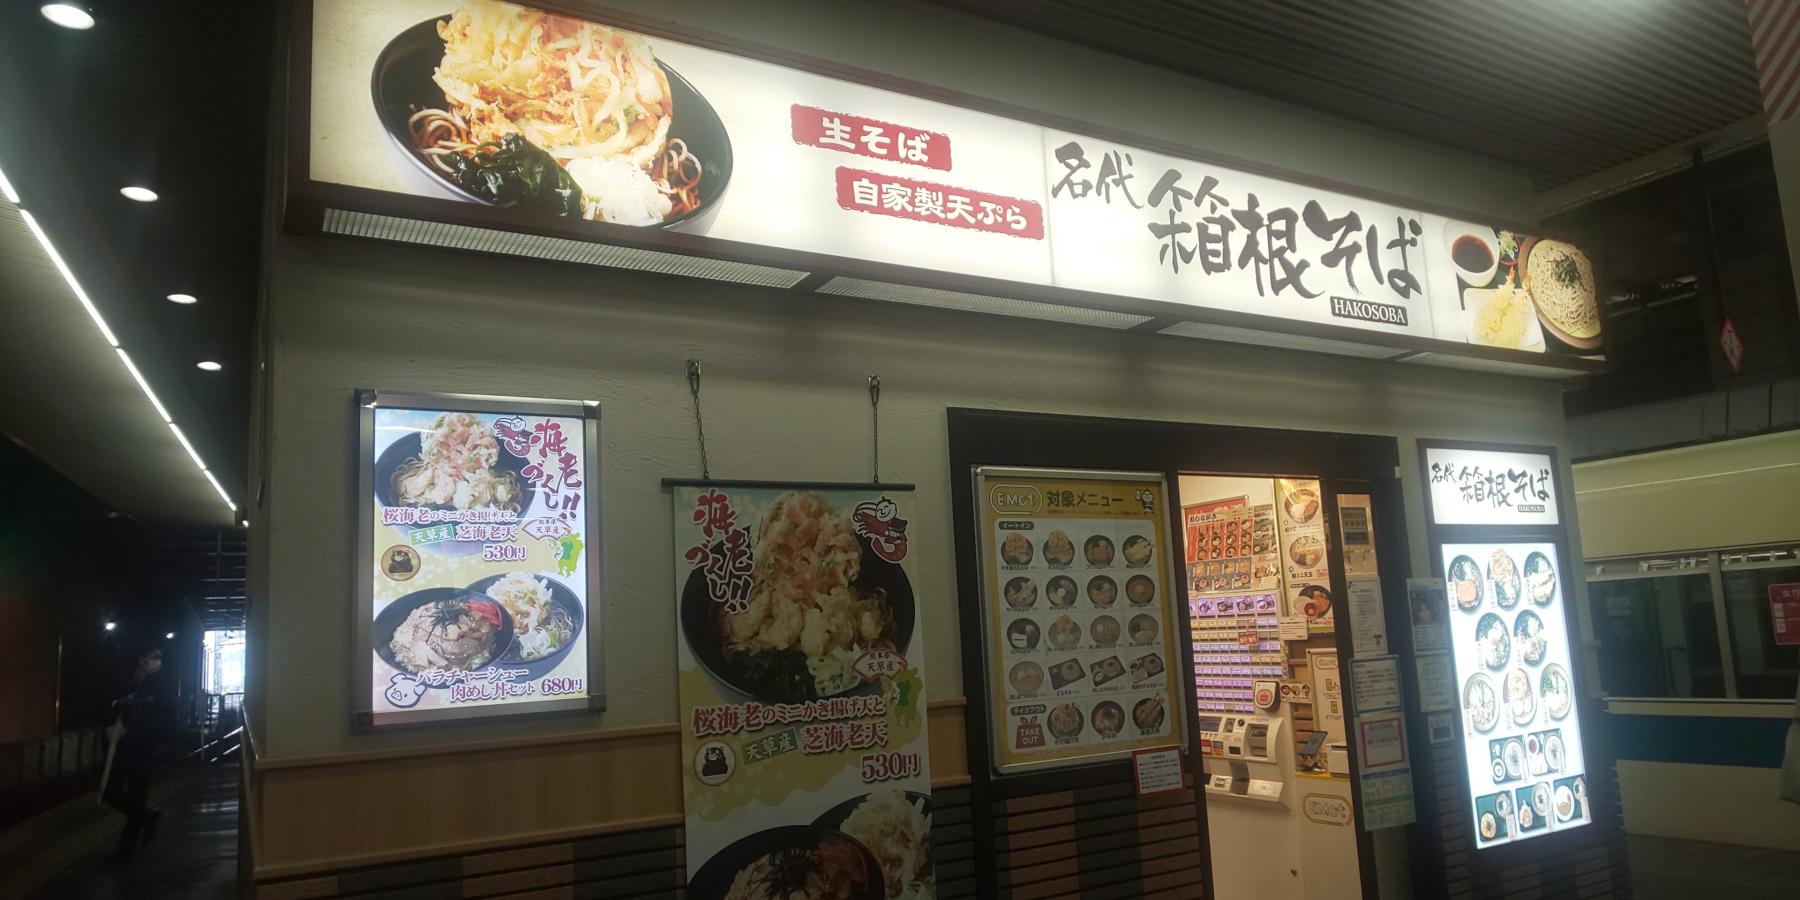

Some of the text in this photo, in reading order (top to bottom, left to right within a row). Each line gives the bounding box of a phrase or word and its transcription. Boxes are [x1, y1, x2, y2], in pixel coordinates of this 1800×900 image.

[819, 117, 932, 164] 生そば
[851, 177, 1028, 231] 自家製天ぷら
[1051, 142, 1424, 299] 名代 箱根そば
[1333, 298, 1407, 324] HAKOSOBA
[1431, 462, 1551, 508] 名代 箱根そば
[1046, 490, 1124, 508] 対象メニュー
[413, 525, 518, 543] 天草産 芝海老天
[483, 543, 526, 561] 530円
[415, 667, 529, 686] バラチャーシュー
[450, 678, 584, 702] 肉めし丼セット 680円
[692, 695, 887, 735] 桜海老のミニかき揚げ天と
[745, 720, 889, 761] 天草産 芝海老天
[1019, 727, 1041, 737] TAKE
[1022, 735, 1038, 745] OUT
[861, 752, 921, 782] 530円
